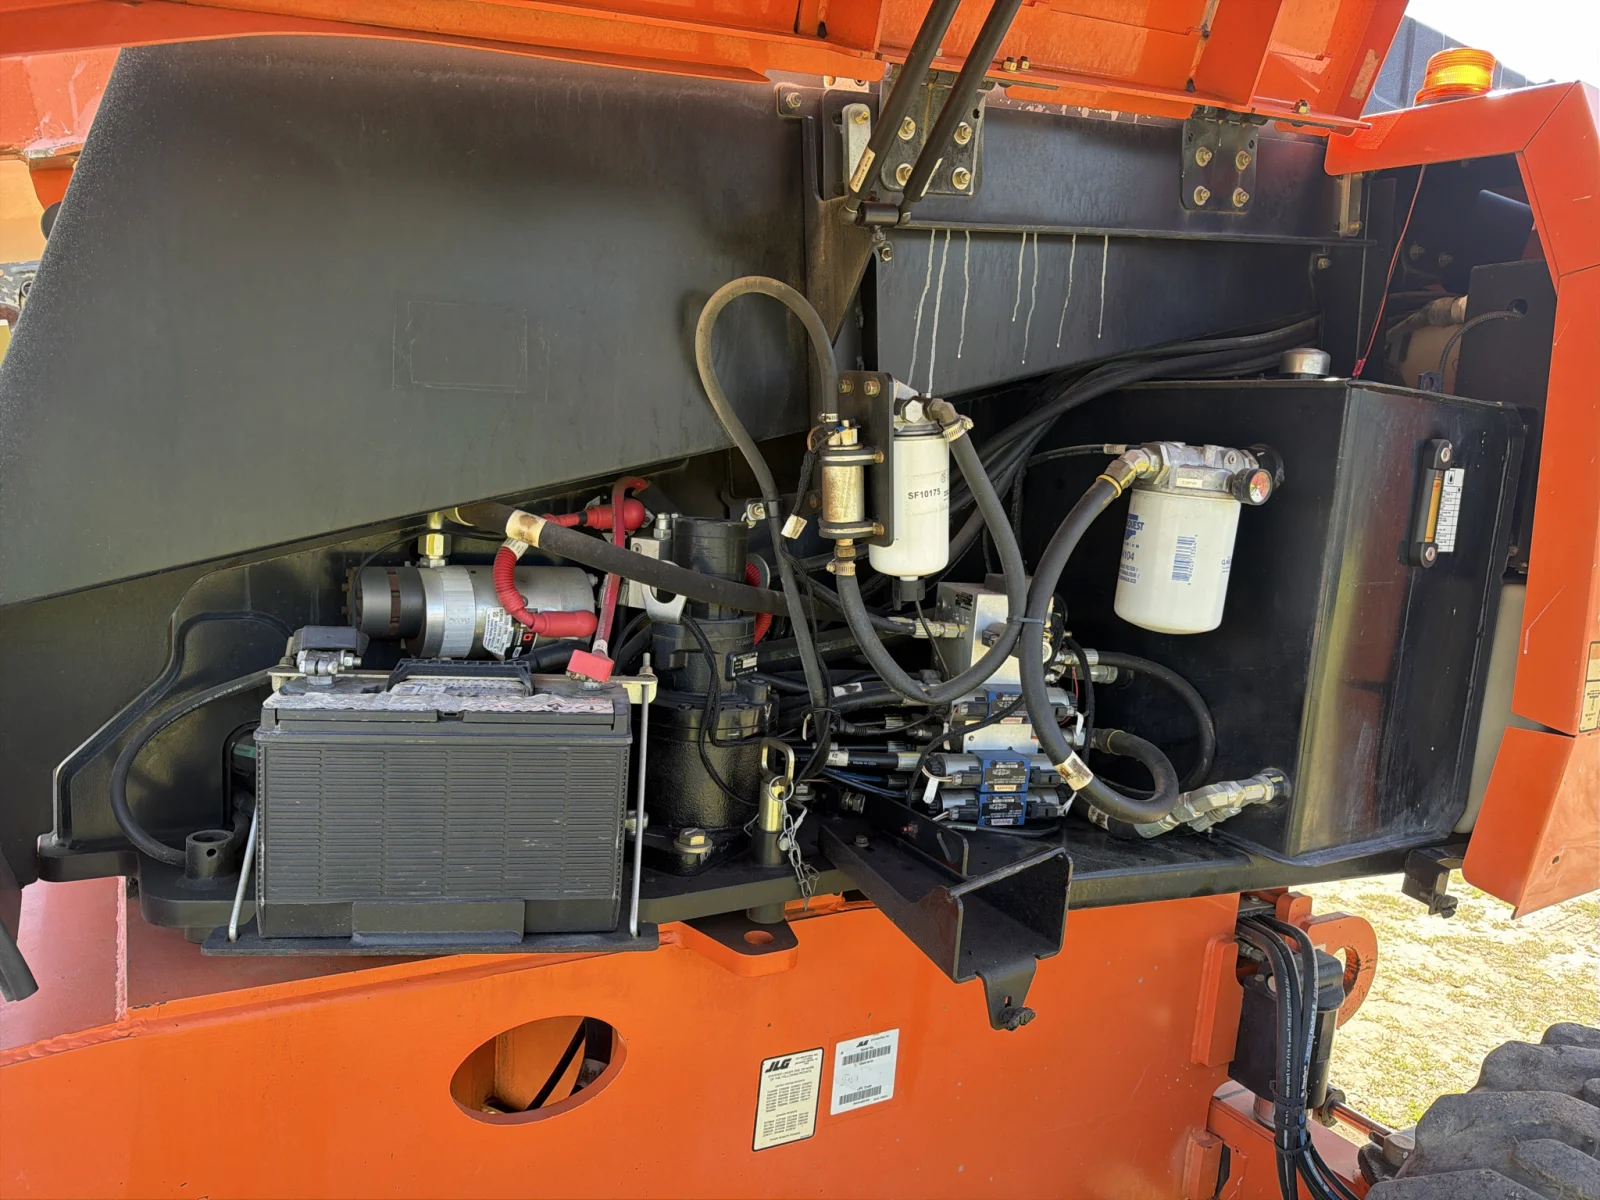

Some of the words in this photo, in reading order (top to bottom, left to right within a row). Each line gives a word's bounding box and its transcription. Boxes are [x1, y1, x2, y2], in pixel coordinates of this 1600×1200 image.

[908, 488, 940, 500] SF10175
[1128, 521, 1144, 531] QUEST
[765, 1058, 792, 1073] JLG
